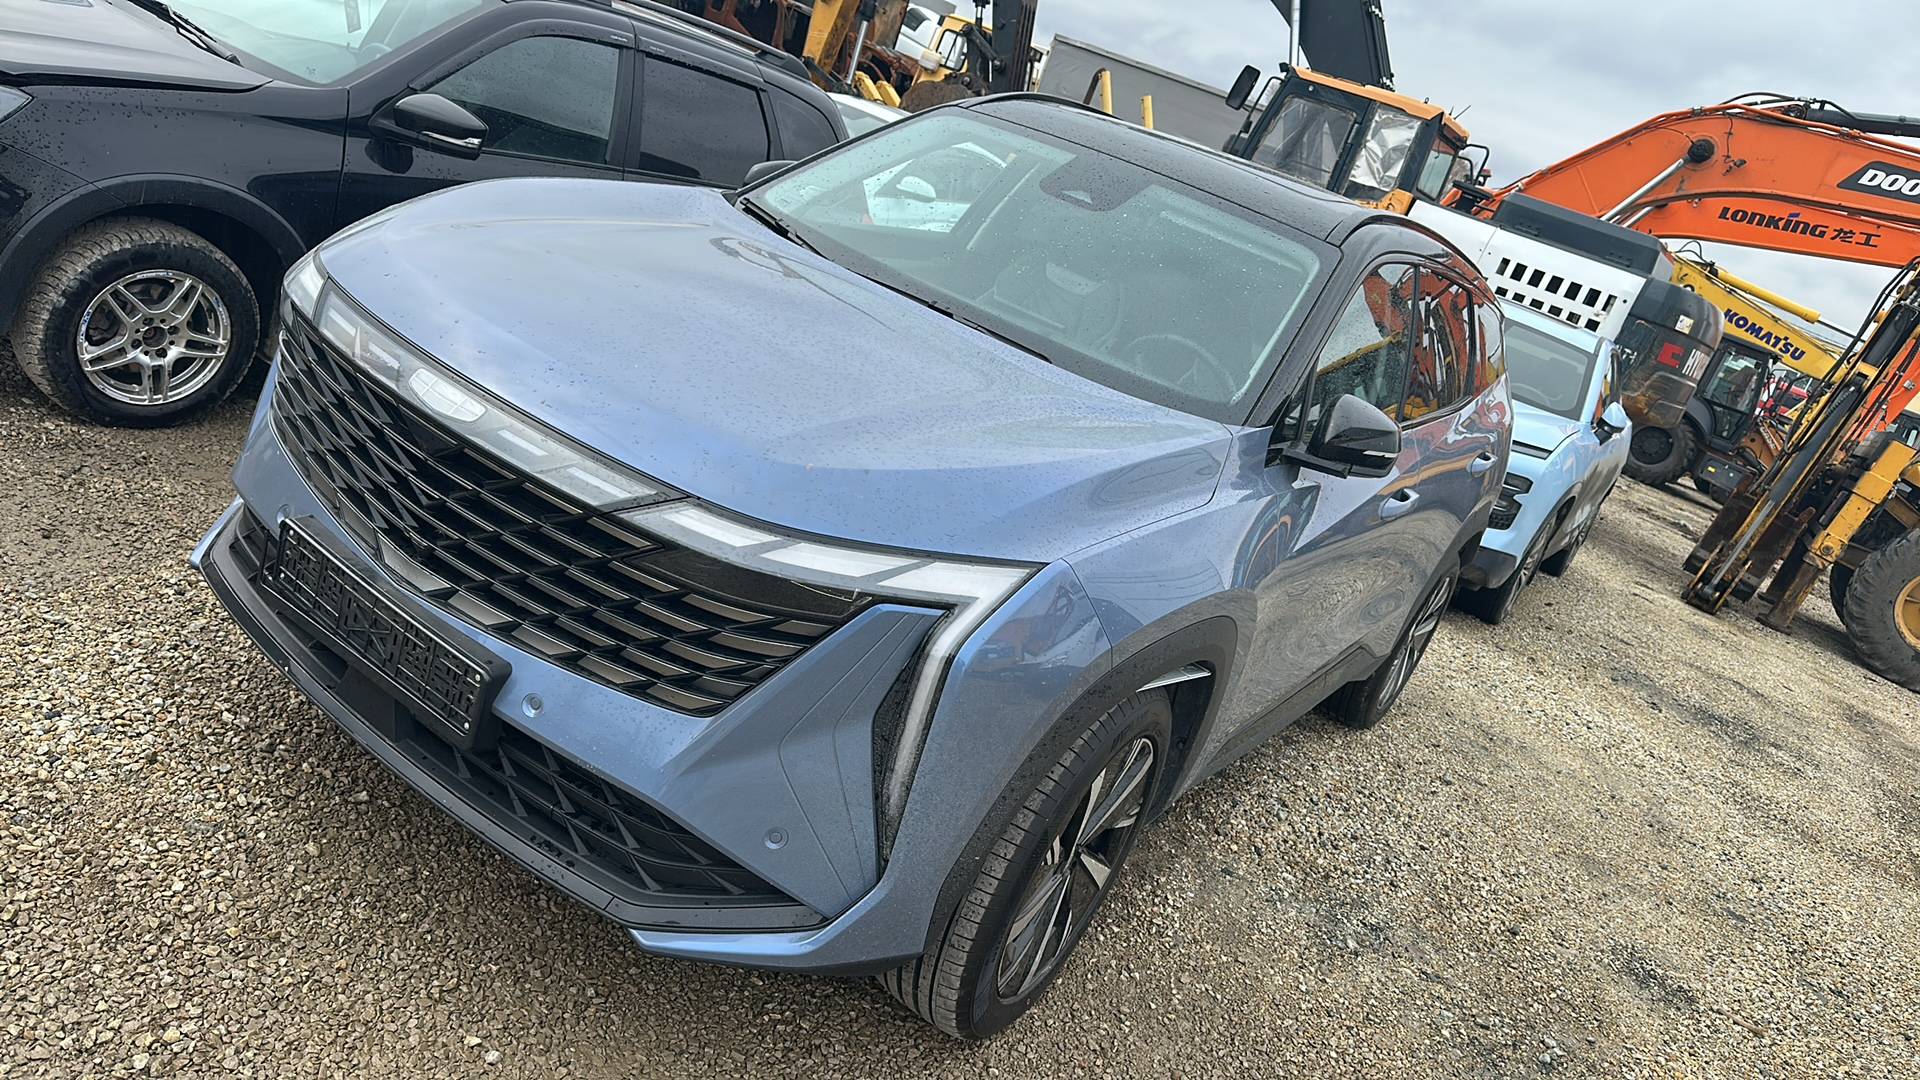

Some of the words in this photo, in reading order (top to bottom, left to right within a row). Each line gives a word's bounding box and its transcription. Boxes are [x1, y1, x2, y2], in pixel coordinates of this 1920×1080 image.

[1857, 168, 1920, 196] DOO
[1829, 227, 1881, 248] 龙工
[1724, 308, 1806, 361] KOMATSU
